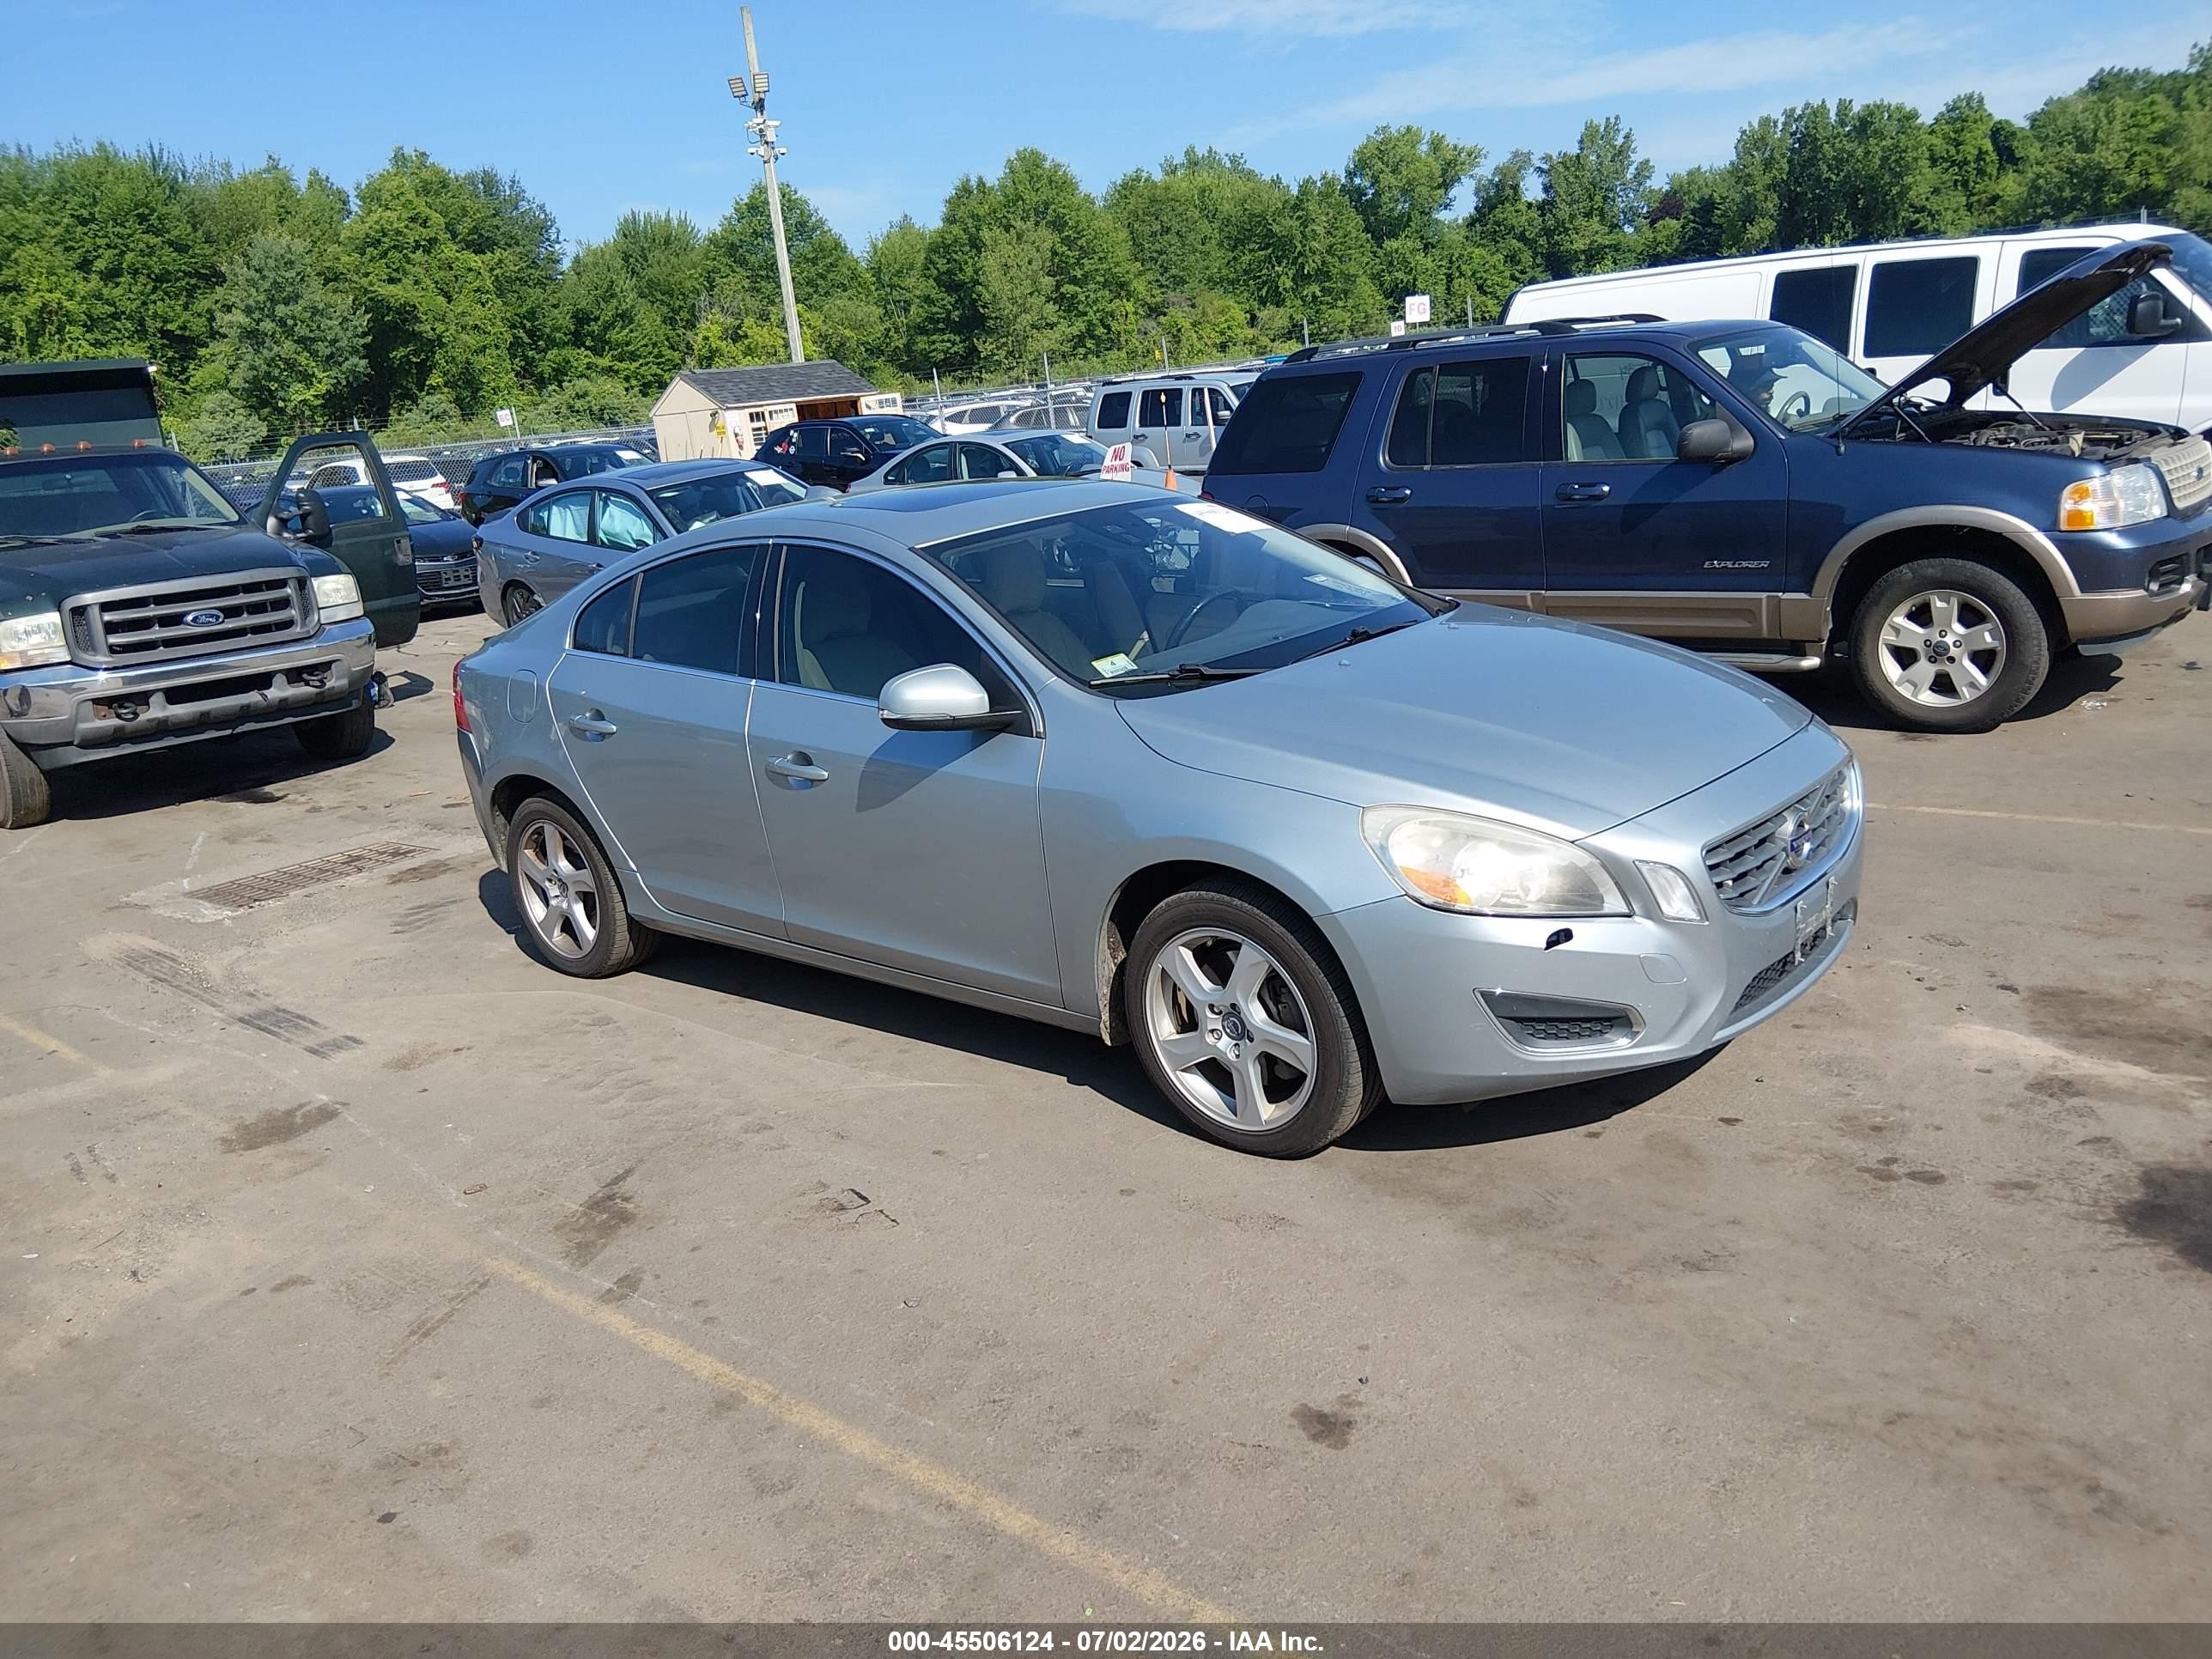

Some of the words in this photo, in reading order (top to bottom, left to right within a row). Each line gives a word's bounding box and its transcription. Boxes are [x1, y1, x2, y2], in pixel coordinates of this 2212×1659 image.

[1408, 301, 1427, 316] FG
[1394, 325, 1402, 333] 10
[1110, 445, 1126, 462] NO
[1102, 462, 1130, 474] PARKING
[1703, 560, 1771, 568] EXPLORER
